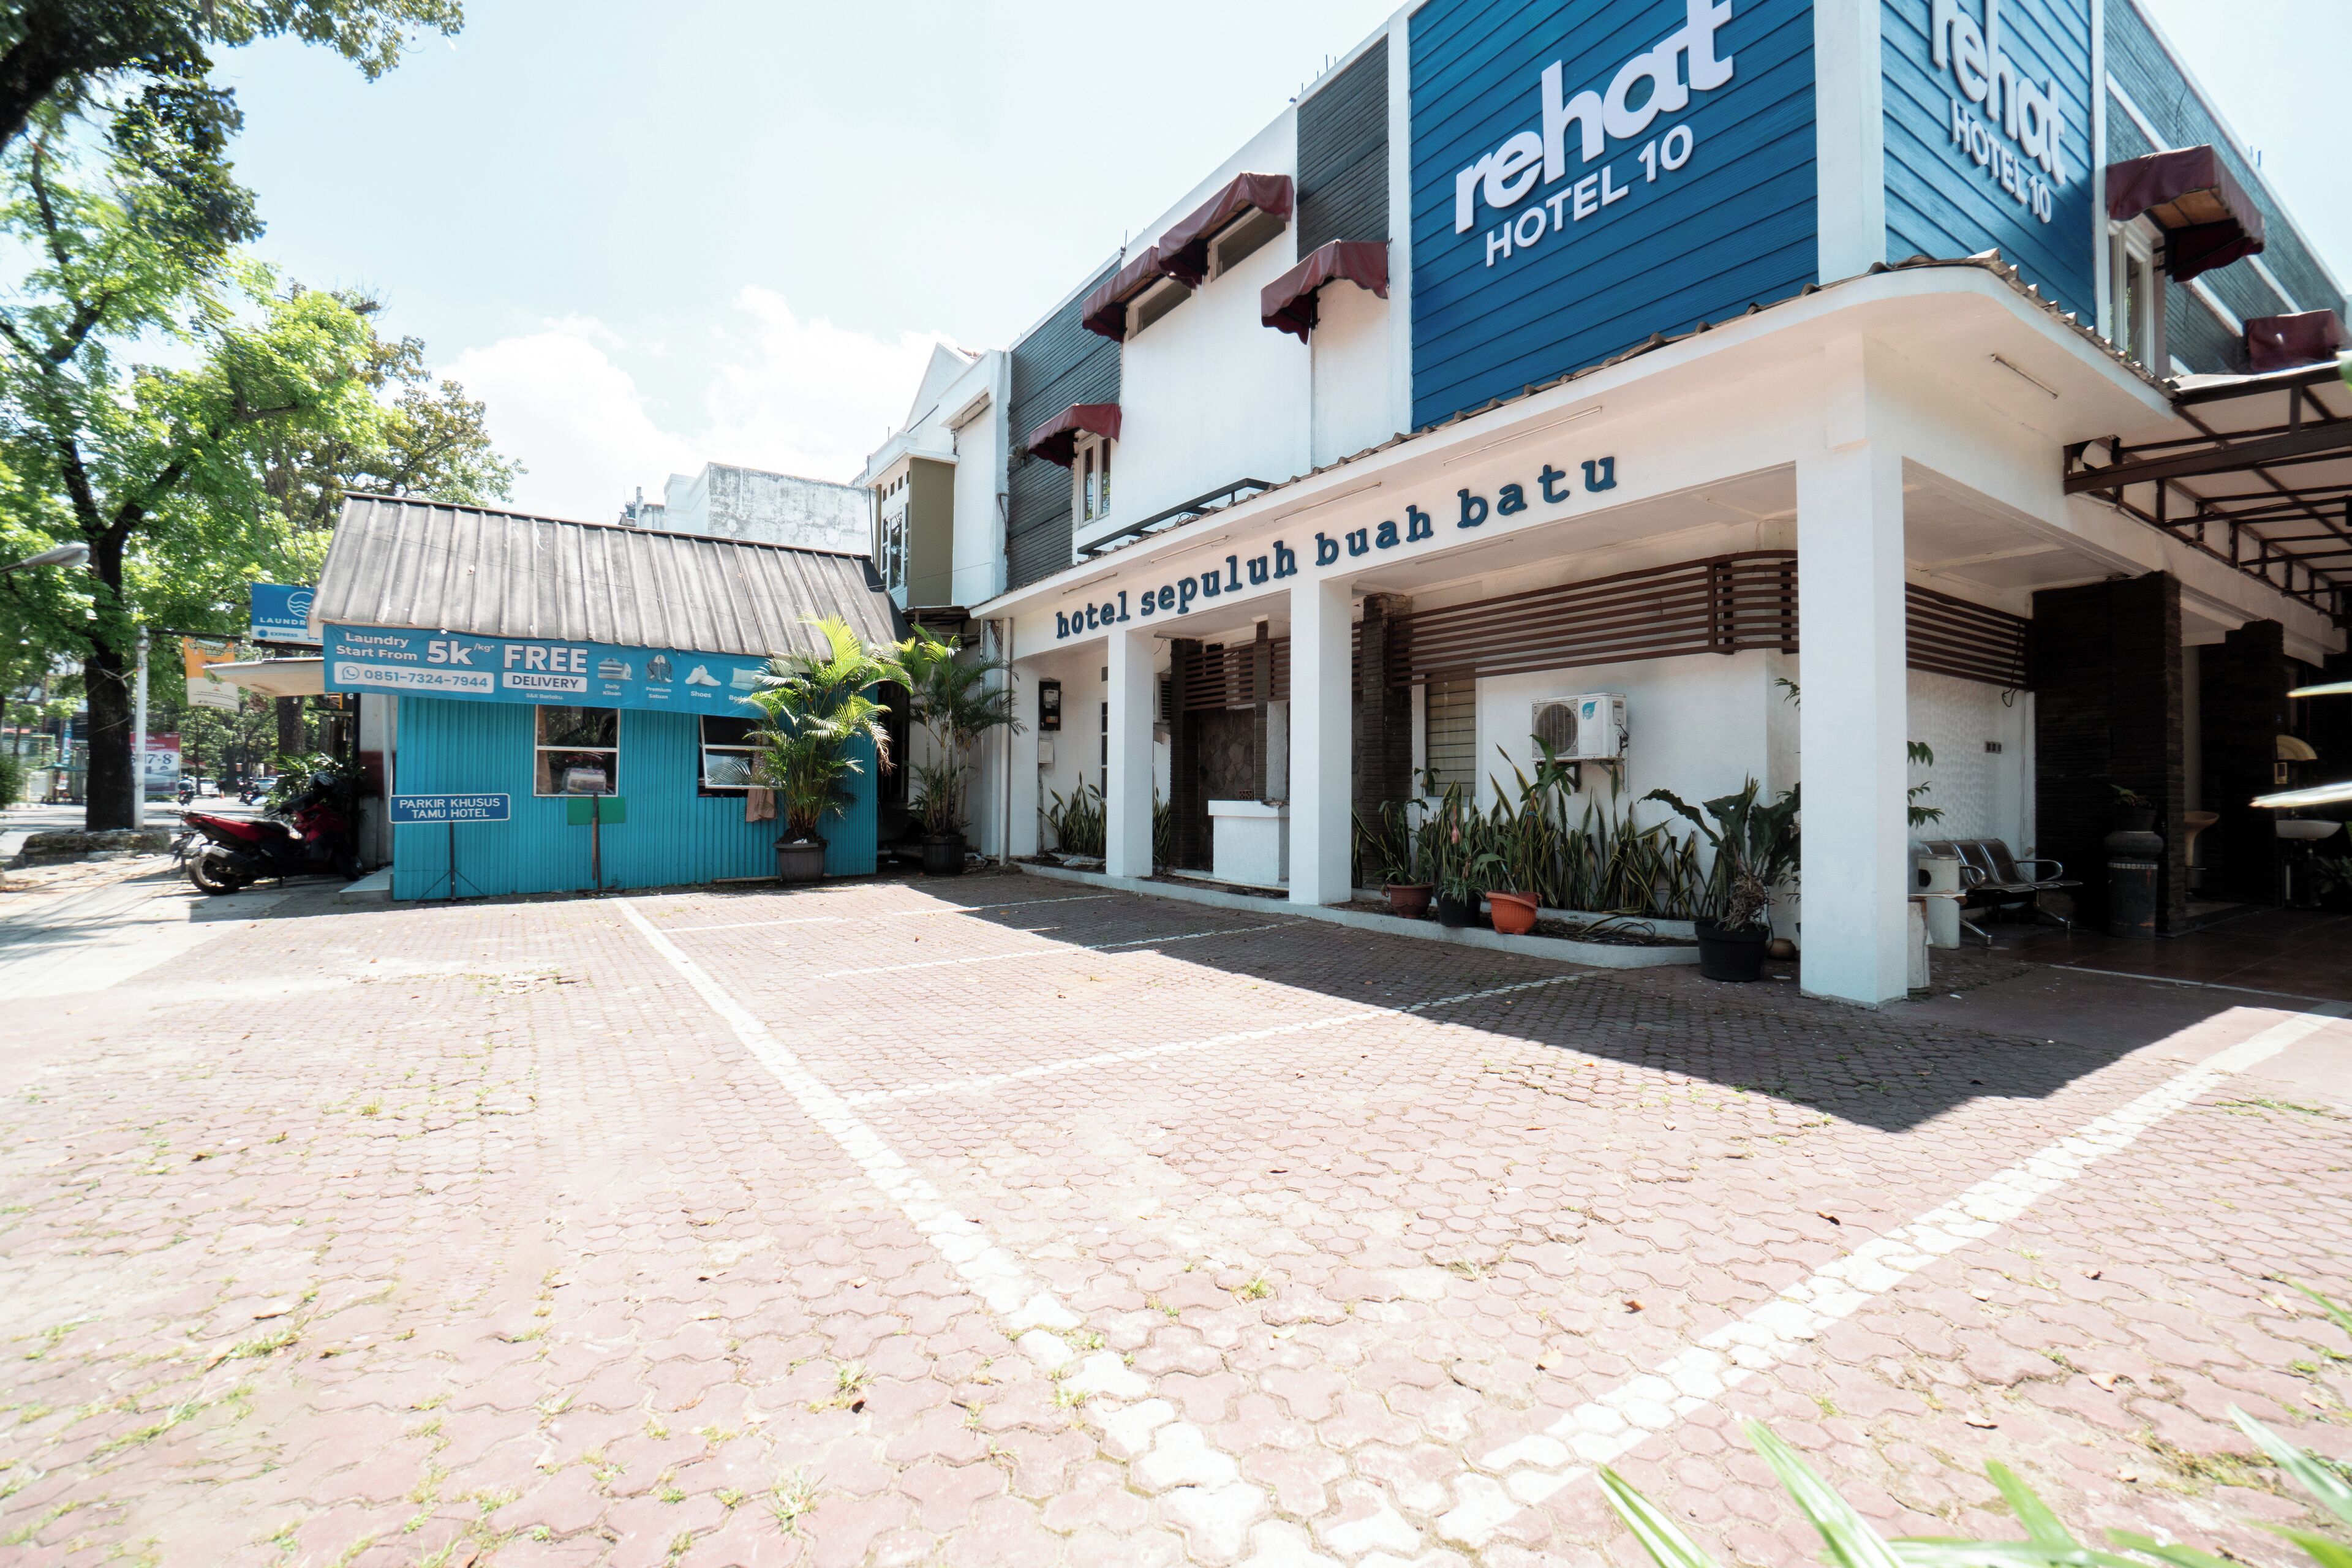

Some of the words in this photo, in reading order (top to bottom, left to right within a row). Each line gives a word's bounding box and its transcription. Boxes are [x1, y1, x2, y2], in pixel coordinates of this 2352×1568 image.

[1931, 0, 2066, 185] rehat
[1455, 0, 1734, 235] rehat
[1950, 98, 2028, 205] HOTEL
[2027, 175, 2052, 224] 10
[1486, 164, 1629, 267] HOTEL
[1638, 124, 1694, 183] 10
[1055, 590, 1131, 639] hotel
[1140, 540, 1298, 614] sepuluh
[1315, 504, 1434, 568] buah
[1457, 455, 1617, 529] batu
[345, 632, 409, 648] Laundry
[336, 645, 374, 657] Start
[379, 649, 418, 661] From
[503, 644, 588, 673] FREE
[364, 669, 488, 687] 0851-7324-7944
[512, 675, 579, 689] DELIVERY
[399, 799, 446, 809] PARKIR
[450, 797, 500, 807] KHUSUS
[412, 809, 446, 818] TAMU
[450, 808, 490, 818] HOTEL
